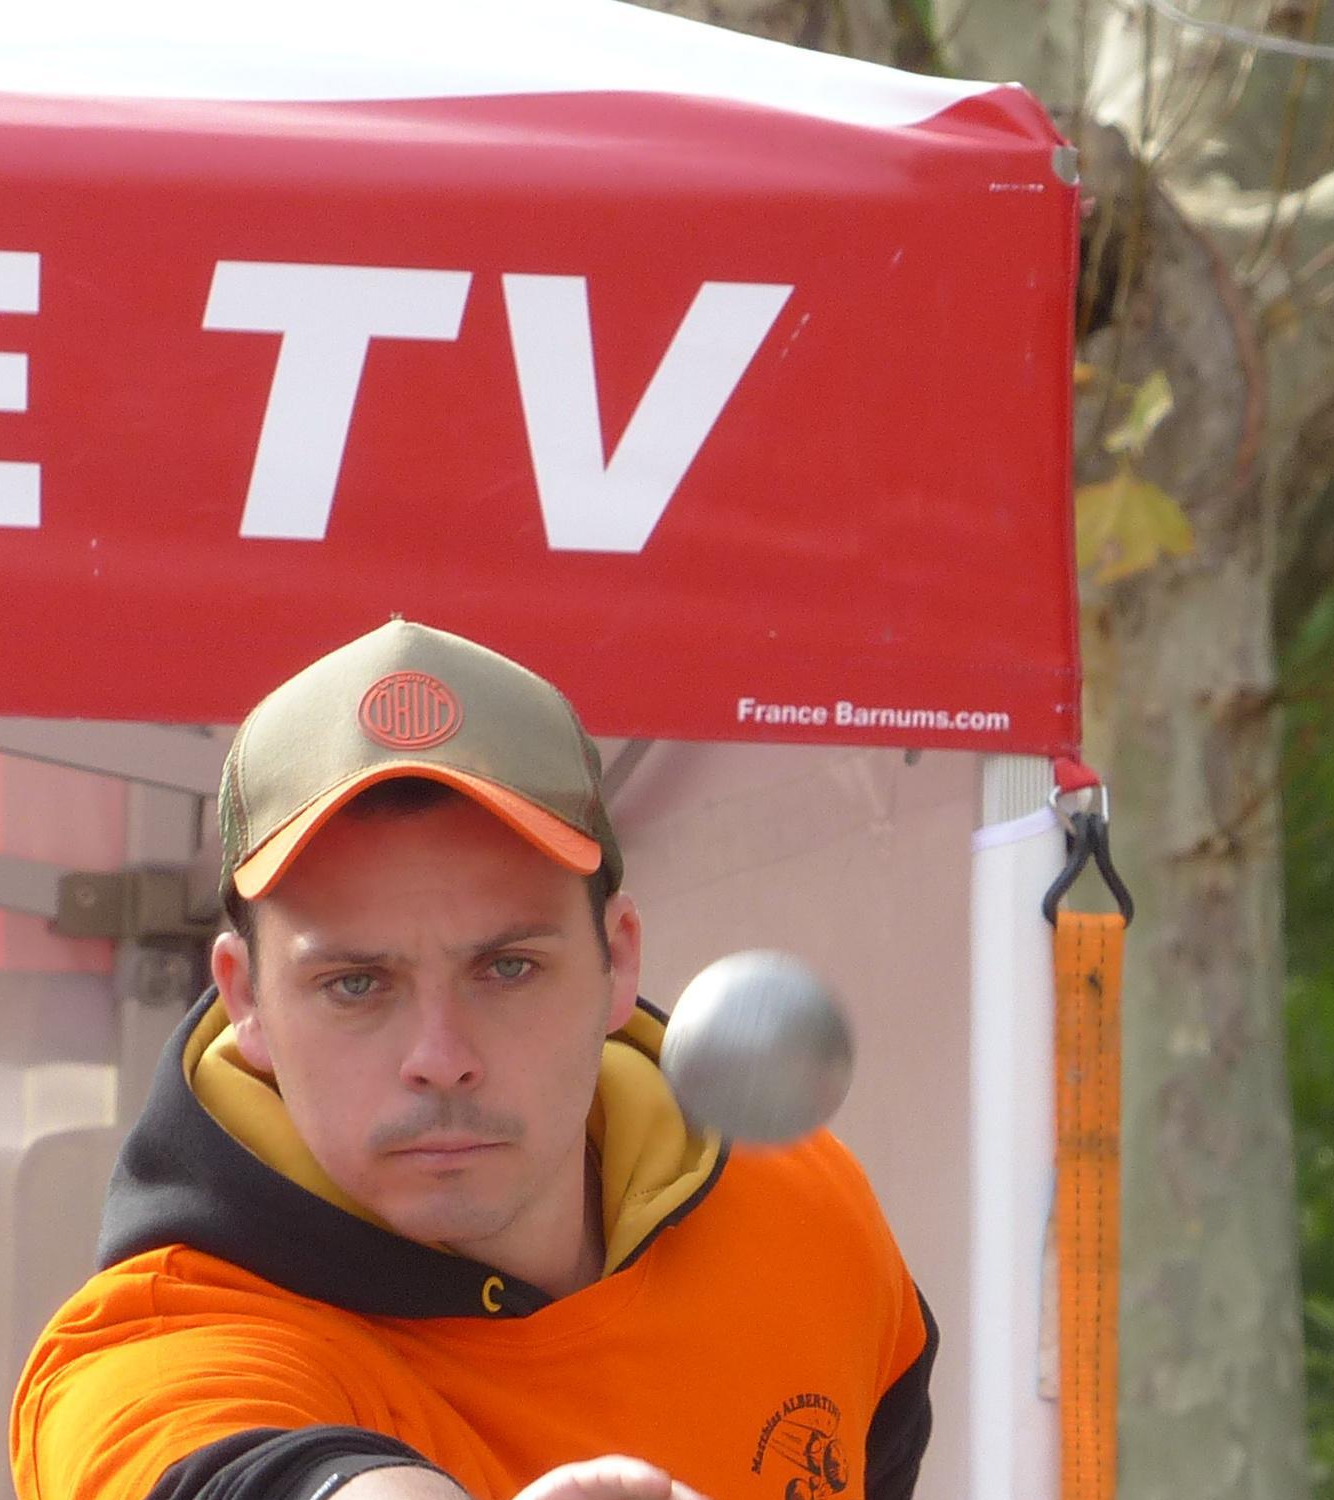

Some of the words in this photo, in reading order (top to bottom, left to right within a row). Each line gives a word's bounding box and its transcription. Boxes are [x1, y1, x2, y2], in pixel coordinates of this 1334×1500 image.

[202, 260, 795, 554] TV
[737, 697, 828, 726] France
[834, 700, 1010, 731] Barnums.com
